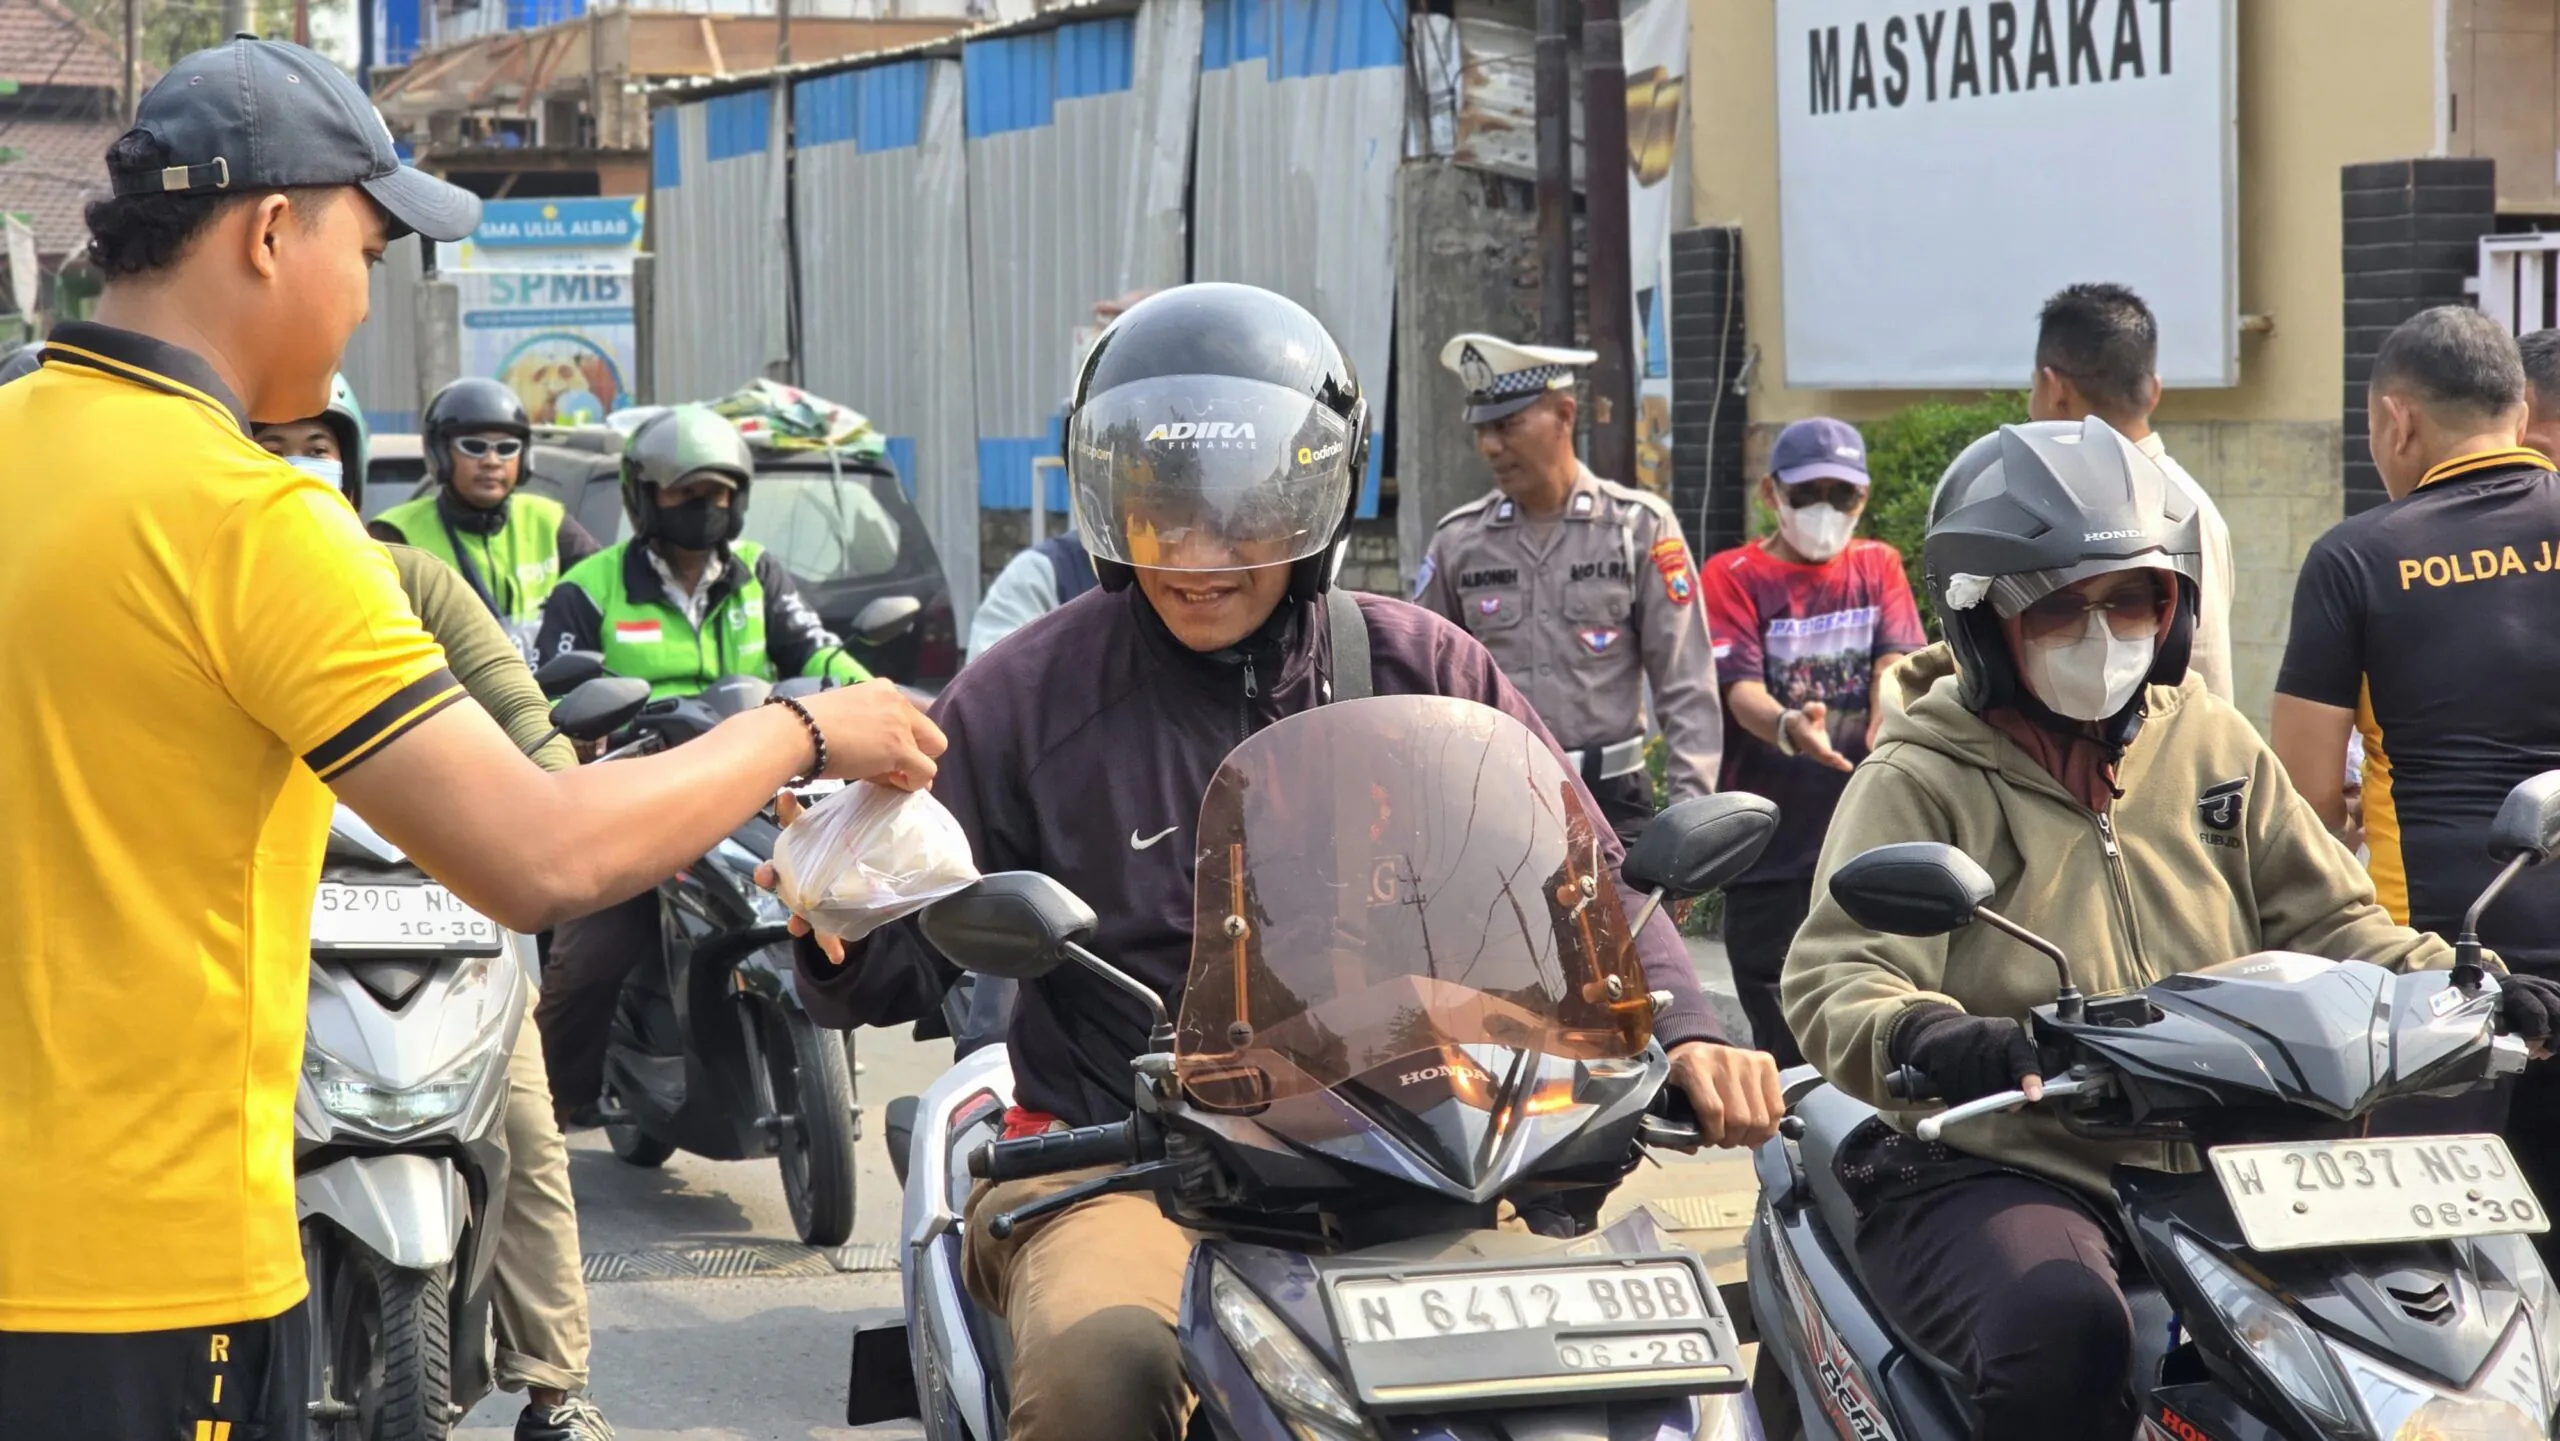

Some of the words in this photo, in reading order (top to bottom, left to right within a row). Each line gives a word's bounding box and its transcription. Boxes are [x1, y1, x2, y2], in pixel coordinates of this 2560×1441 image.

[1809, 0, 2178, 115] MASYARAKAT
[479, 221, 520, 238] SMA
[570, 218, 629, 236] ALBAB
[489, 265, 622, 305] SPMB
[1144, 422, 1256, 442] ADIRA
[1168, 441, 1257, 450] FINANCE
[2399, 545, 2527, 590] POLDA
[2533, 541, 2560, 572] J
[321, 889, 401, 912] 5290
[1399, 1063, 1491, 1086] HONDA
[2229, 1158, 2264, 1195] W
[2284, 1148, 2402, 1191] 2037
[1360, 1296, 1396, 1341] N
[1420, 1284, 1570, 1332] 6412
[1587, 1276, 1691, 1321] BBB
